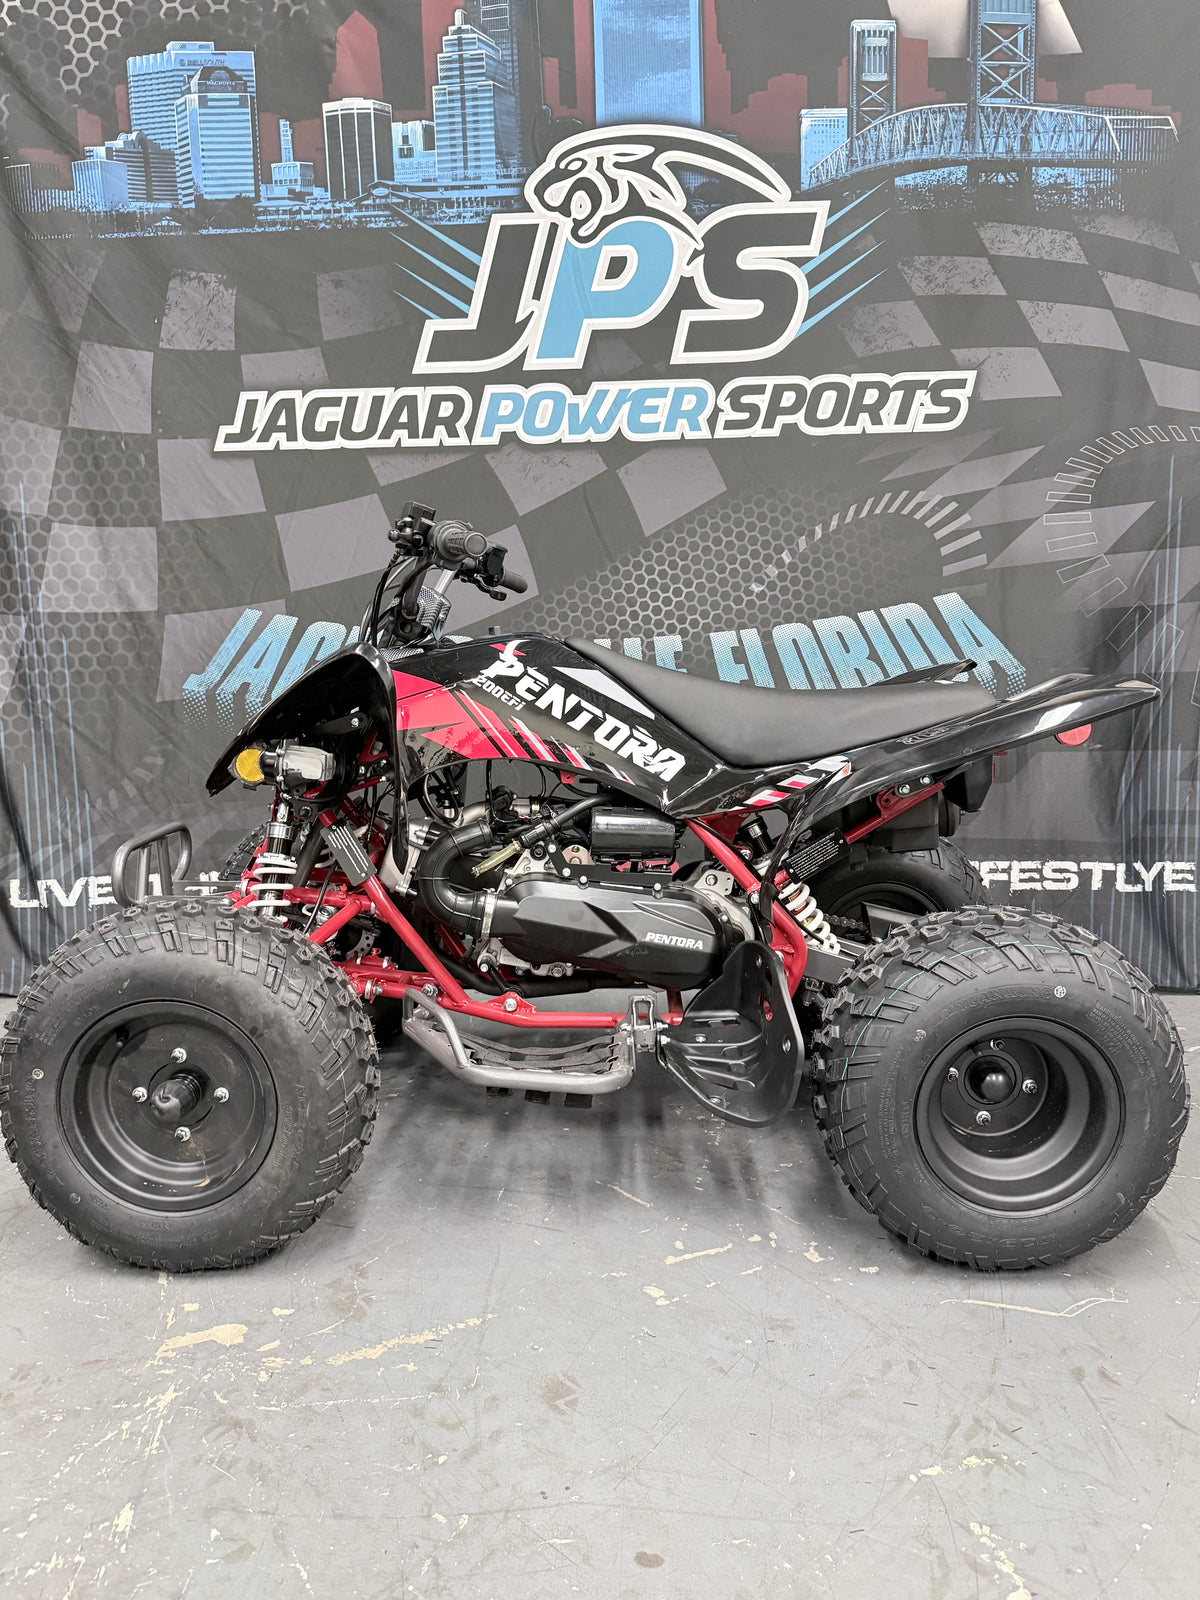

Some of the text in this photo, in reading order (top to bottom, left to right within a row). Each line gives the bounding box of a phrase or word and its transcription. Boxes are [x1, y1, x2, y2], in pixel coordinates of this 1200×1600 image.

[413, 200, 831, 374] JPS
[215, 370, 977, 451] JAGUAR POWER SPORTS
[479, 639, 686, 782] PENTORA
[9, 874, 118, 911] LIVE
[645, 931, 704, 950] PENTORA
